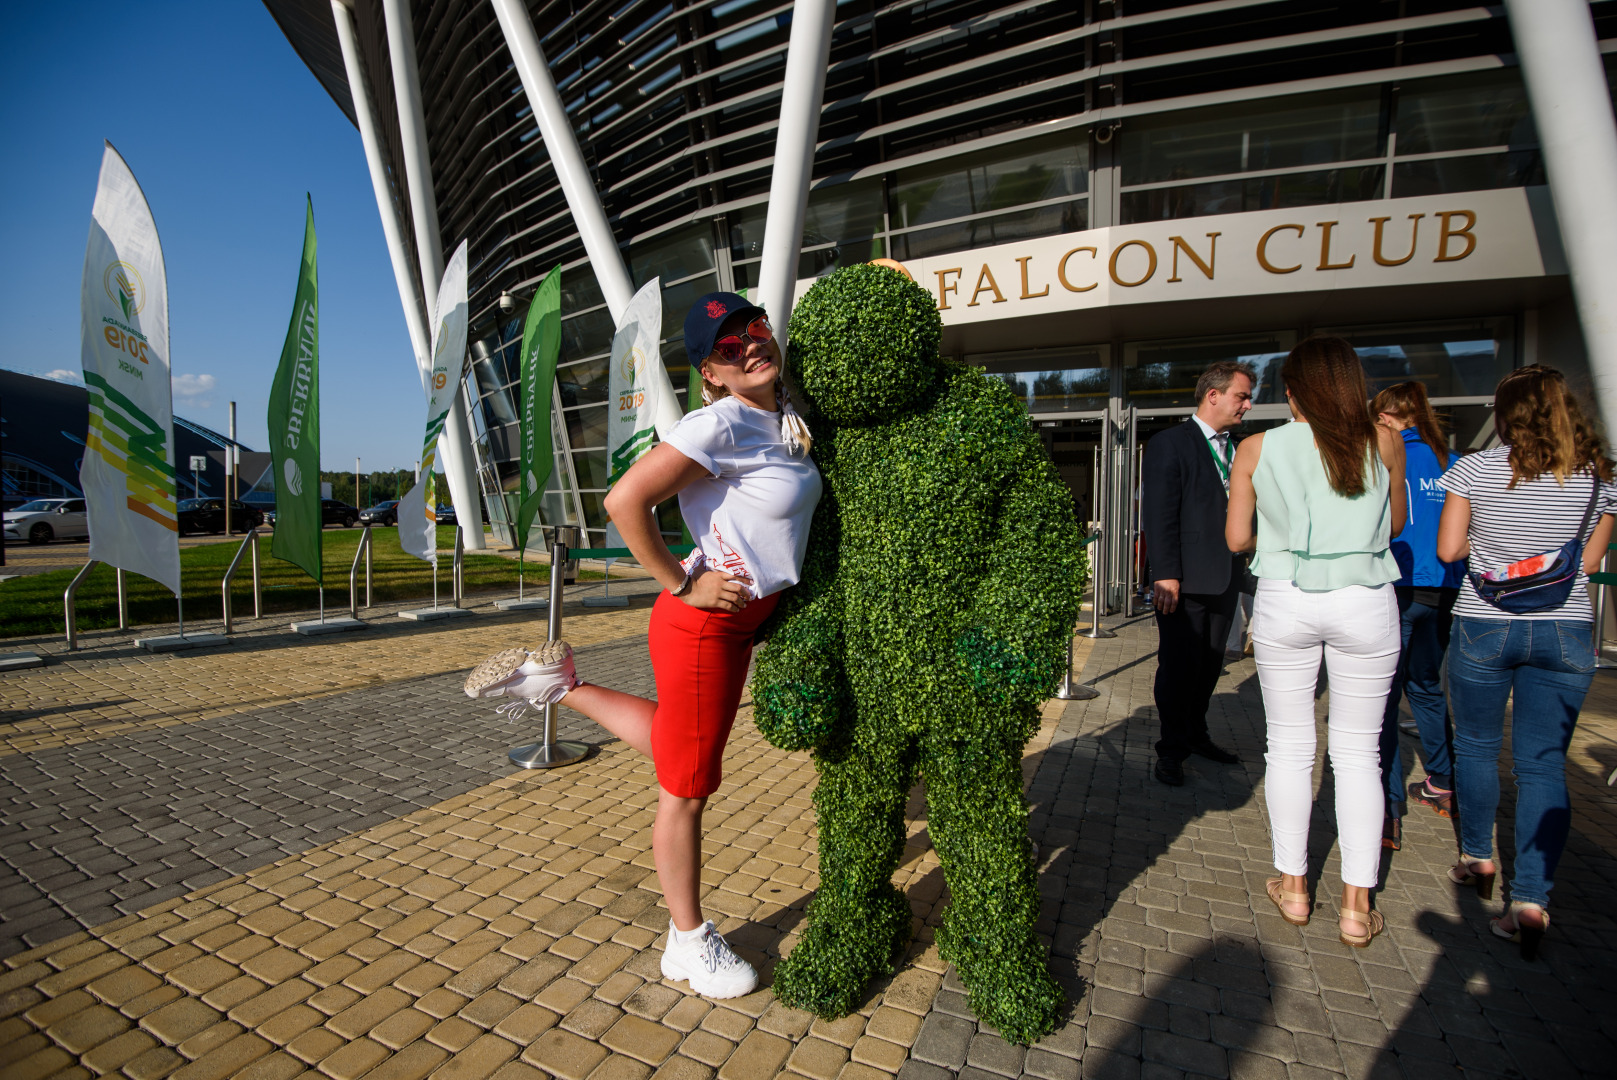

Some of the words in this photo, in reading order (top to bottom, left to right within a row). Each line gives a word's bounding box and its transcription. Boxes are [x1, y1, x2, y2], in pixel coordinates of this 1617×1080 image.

[933, 231, 1222, 311] FALCON
[1256, 209, 1478, 275] CLUB
[619, 392, 644, 411] 2019
